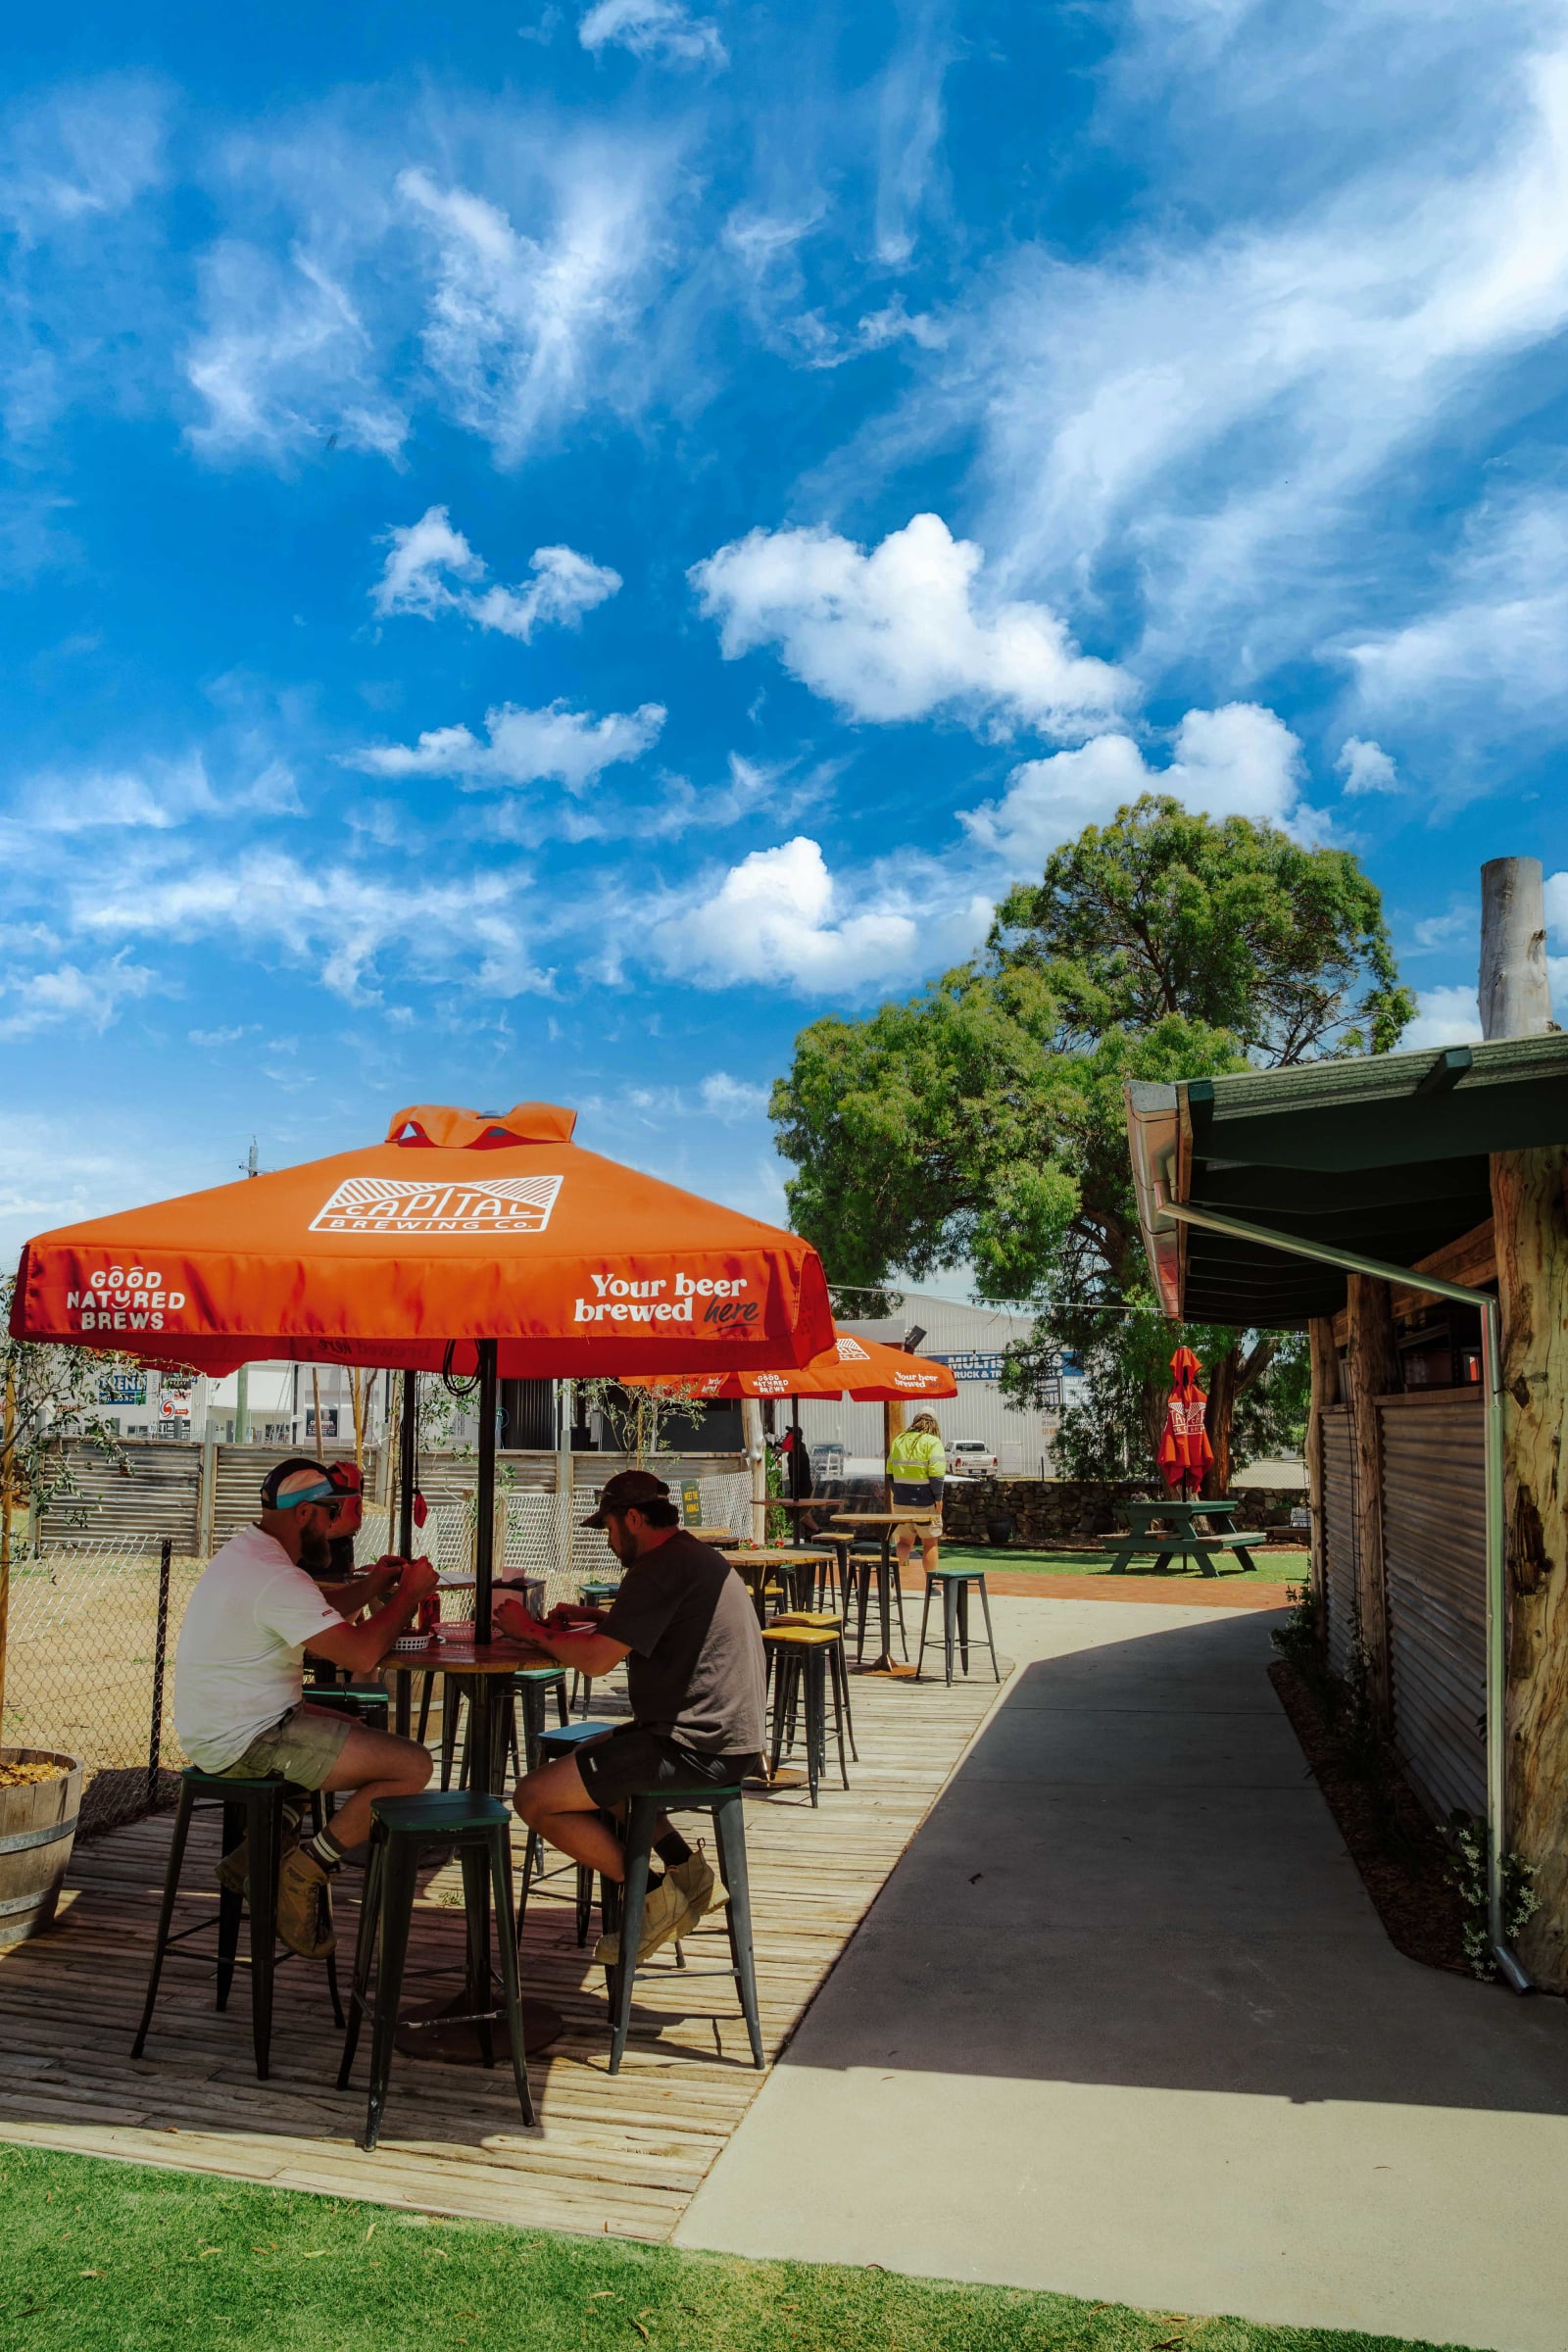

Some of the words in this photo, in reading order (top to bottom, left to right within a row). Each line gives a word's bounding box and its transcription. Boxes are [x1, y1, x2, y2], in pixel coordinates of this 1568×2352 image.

[345, 1187, 531, 1217] CAPITAL
[329, 1219, 480, 1230] BREWING
[494, 1219, 533, 1230] Co.
[90, 1269, 162, 1289] GOOD
[590, 1273, 666, 1298] Your
[673, 1272, 748, 1298] beer
[67, 1291, 186, 1309] NATURED
[573, 1297, 694, 1323] brewed
[703, 1294, 760, 1324] here
[81, 1311, 165, 1330] BREWS
[752, 1379, 789, 1388] NATURED
[894, 1377, 926, 1388] brewed
[896, 1371, 916, 1381] Your
[918, 1373, 938, 1382] beer
[981, 1370, 989, 1379] &
